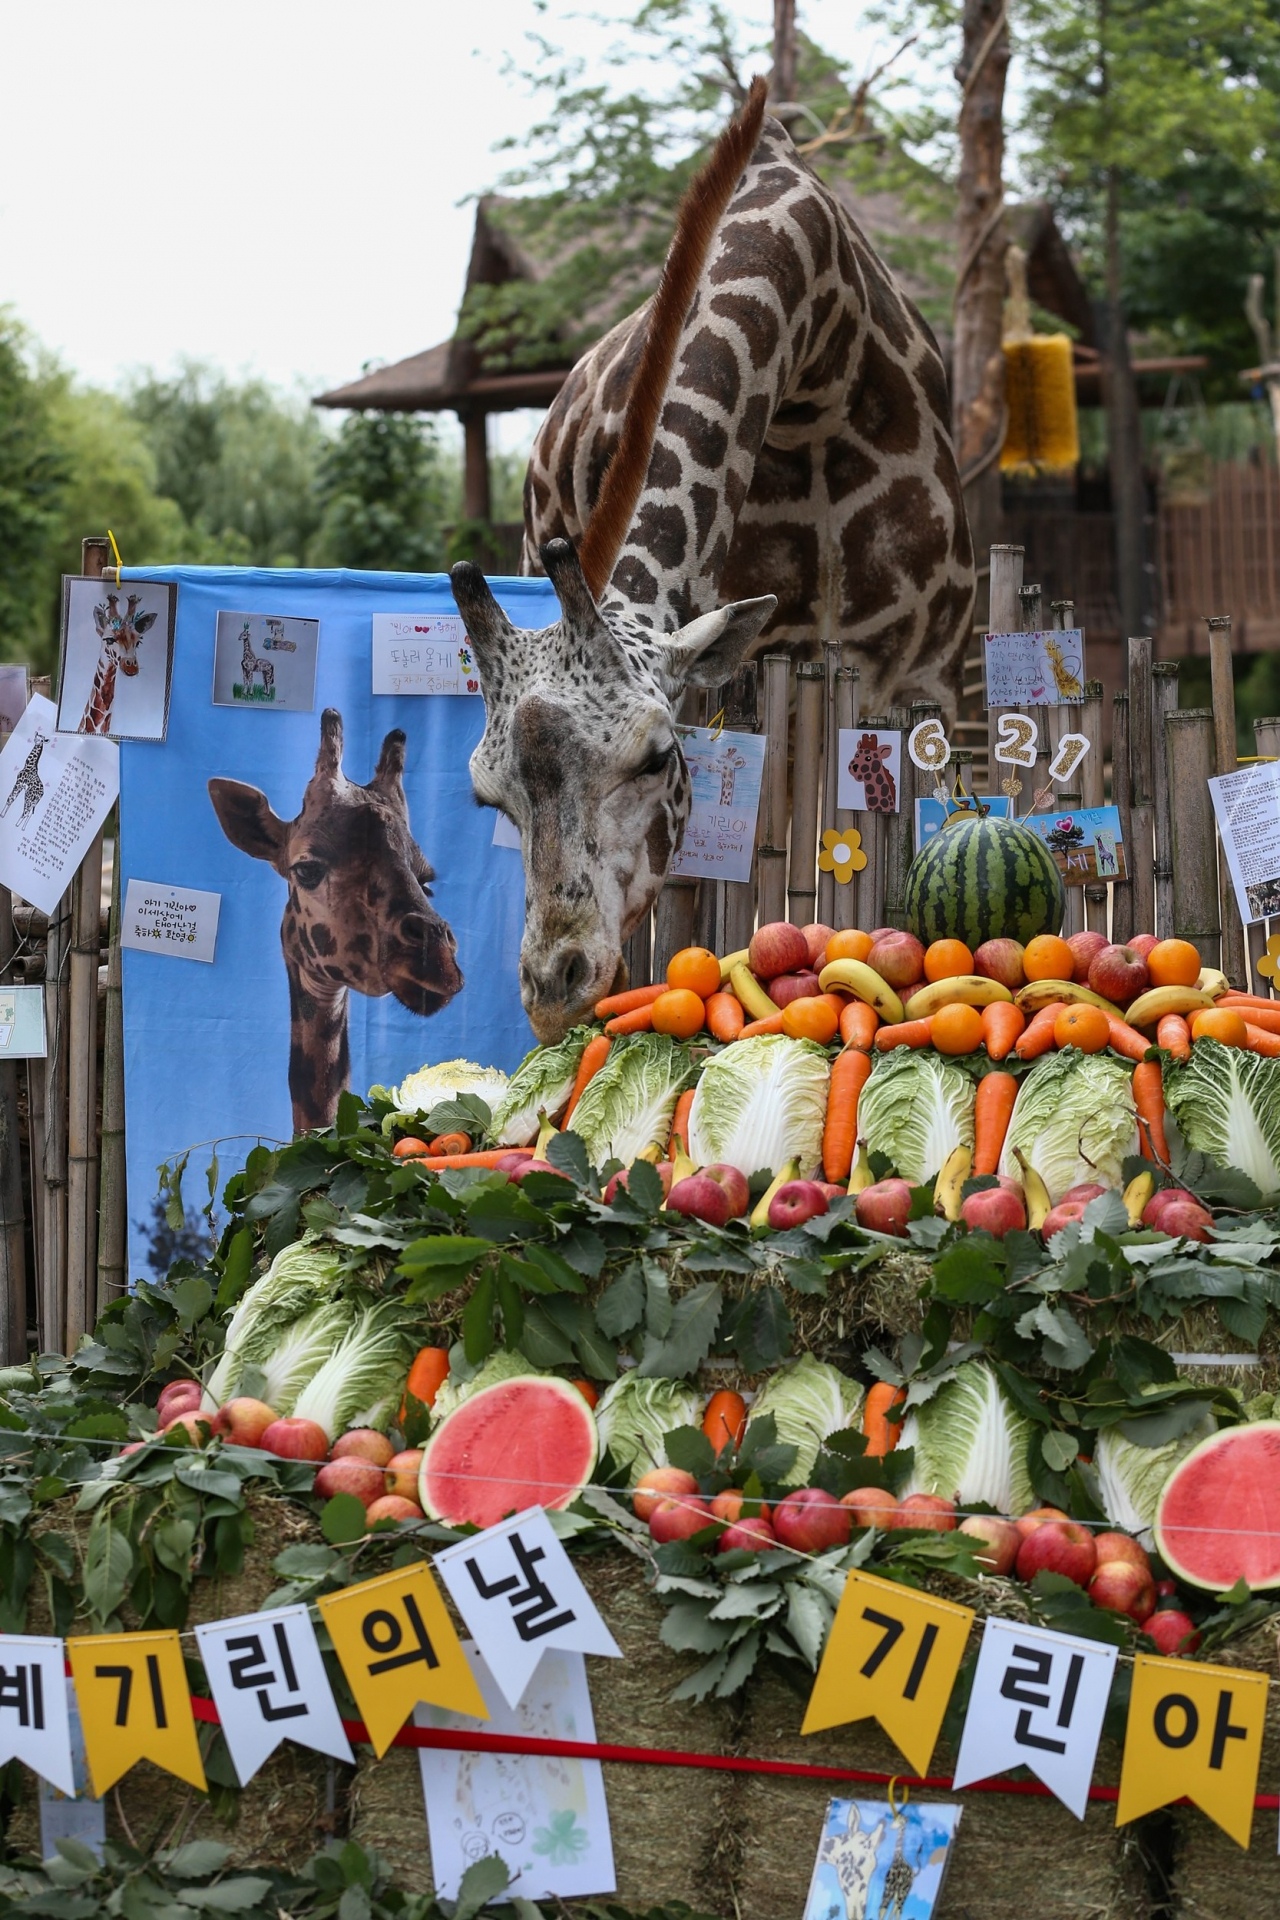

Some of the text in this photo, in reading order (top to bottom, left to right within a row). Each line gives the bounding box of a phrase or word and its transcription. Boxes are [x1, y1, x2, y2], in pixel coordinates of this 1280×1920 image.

[911, 720, 949, 769] 6
[707, 816, 747, 832] 기린아
[144, 899, 189, 912] 아기 기린아
[859, 1606, 1247, 1770] 기린아
